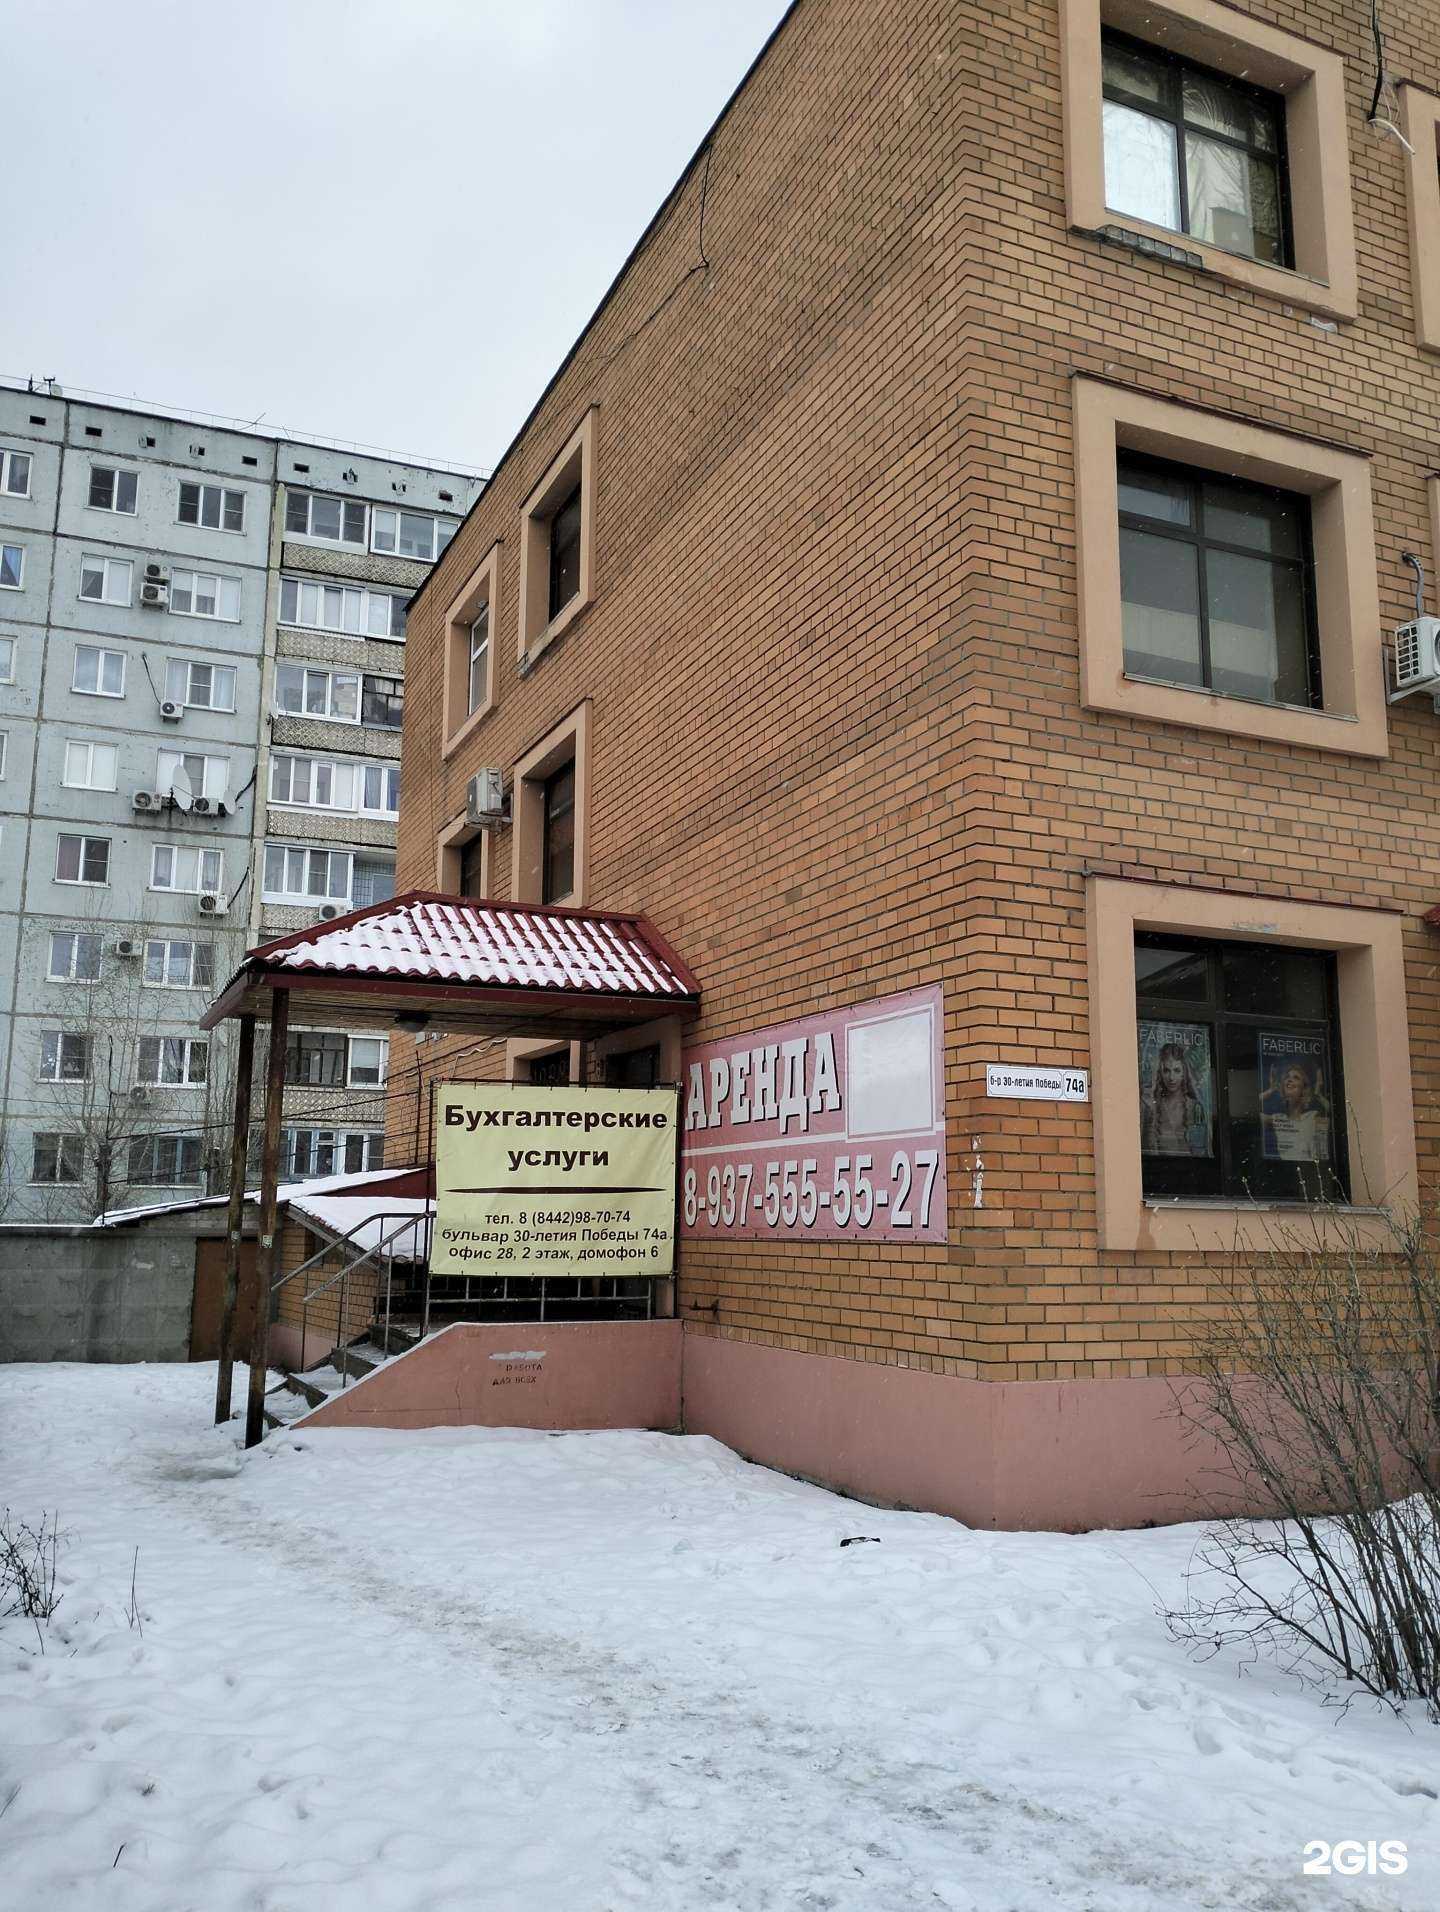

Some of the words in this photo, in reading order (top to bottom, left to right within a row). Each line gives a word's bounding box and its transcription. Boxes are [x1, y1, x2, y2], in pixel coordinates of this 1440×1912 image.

[1141, 1029, 1203, 1046] FABERLIC
[1263, 1038, 1321, 1054] FABERLIC
[684, 1032, 842, 1134] АРЕНДА
[990, 1076, 1002, 1087] б-р
[1003, 1076, 1034, 1088] 30-летия
[1035, 1078, 1062, 1089] Победы
[1065, 1078, 1085, 1093] 74а
[445, 1104, 668, 1132] Бухгалтерские
[508, 1150, 609, 1171] услуги
[684, 1149, 939, 1229] 8-937-555-55-27
[485, 1214, 514, 1225] тел.
[519, 1211, 527, 1224] 8
[532, 1210, 631, 1227] (8442)98-70-74
[442, 1228, 509, 1245] бульвар
[513, 1229, 577, 1242] 30-летия
[582, 1228, 639, 1242] Победы
[643, 1228, 668, 1240] 74а
[449, 1246, 492, 1260] офис
[496, 1247, 517, 1260] 28,
[522, 1247, 531, 1259] 2
[535, 1248, 574, 1260] этаж,
[577, 1246, 646, 1261] домофон
[650, 1245, 659, 1257] 6
